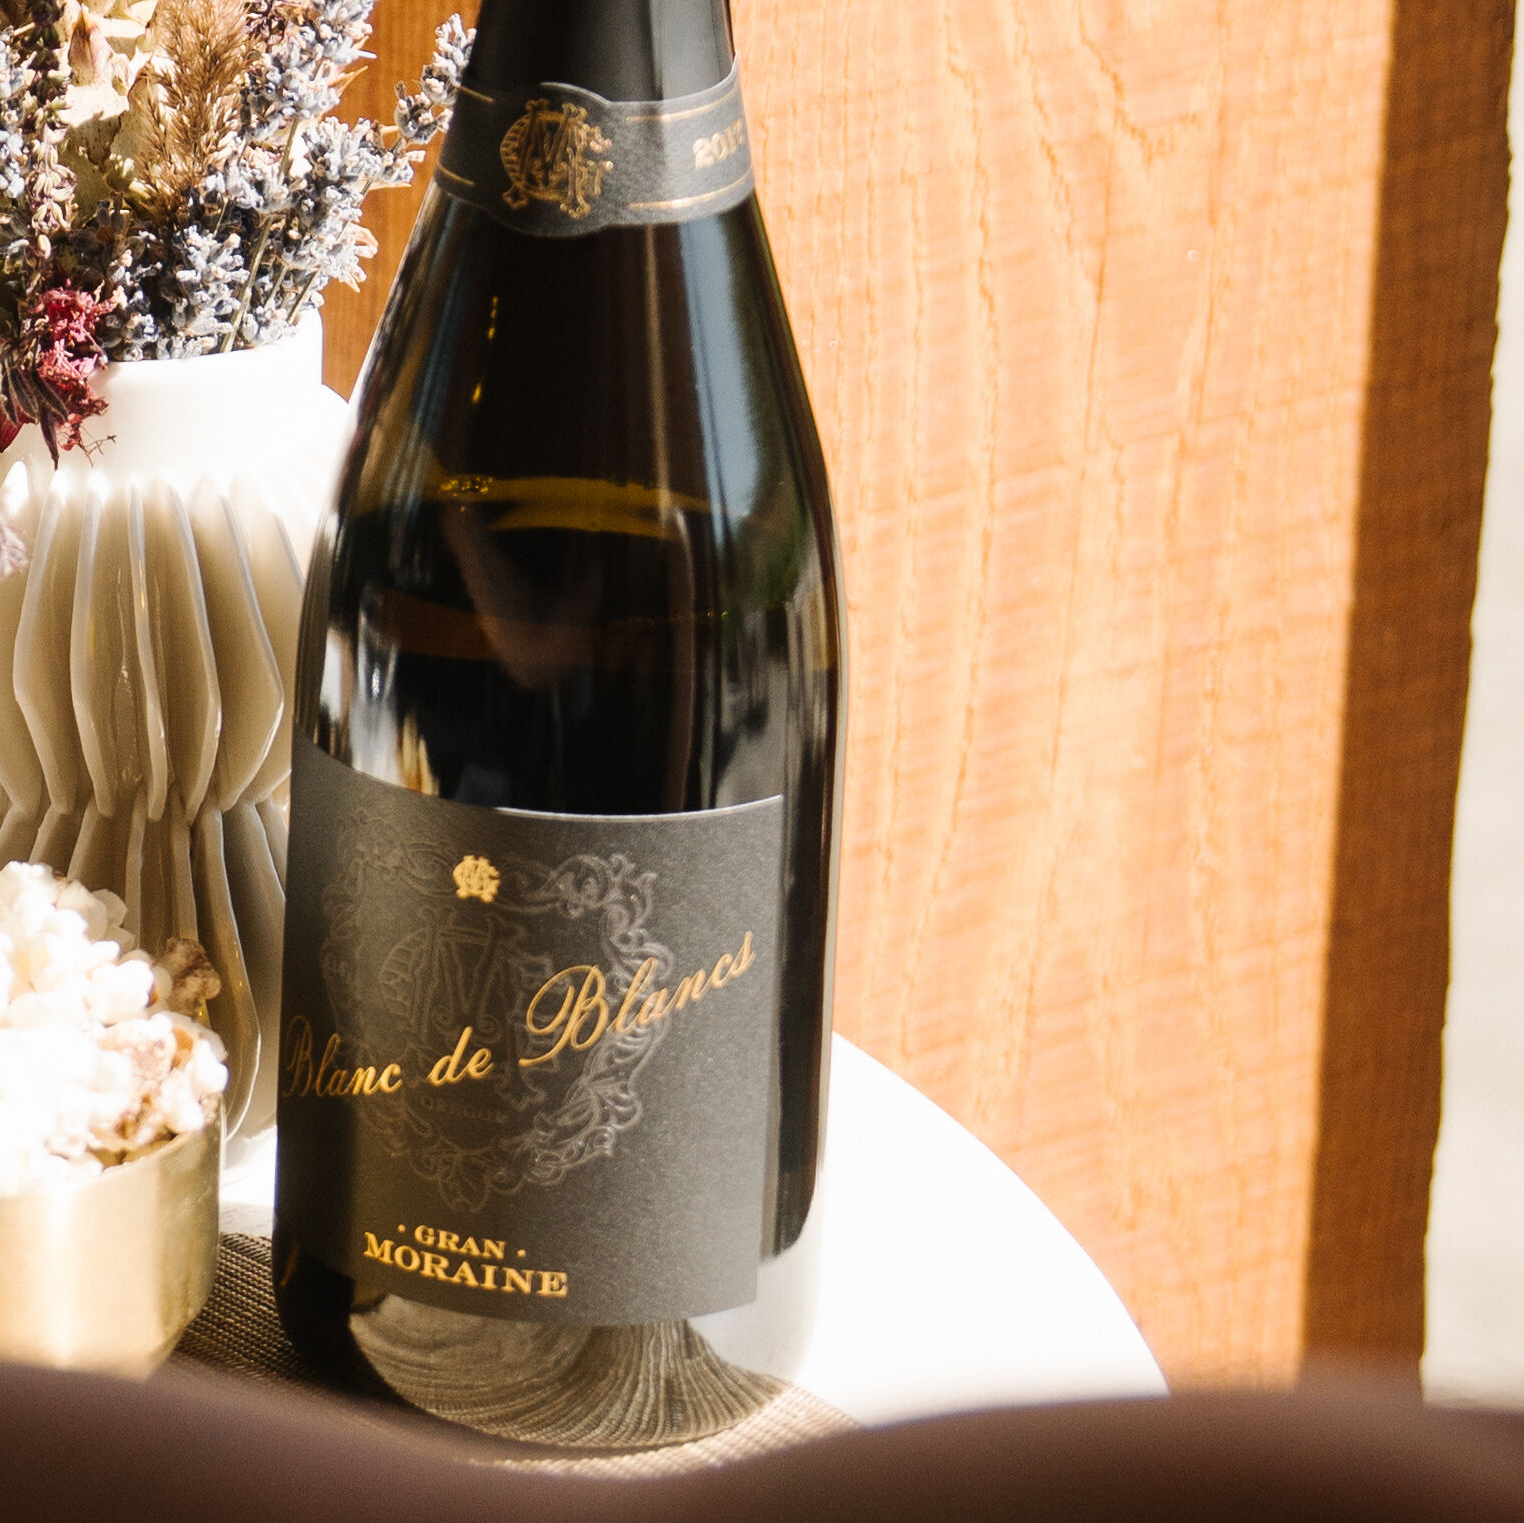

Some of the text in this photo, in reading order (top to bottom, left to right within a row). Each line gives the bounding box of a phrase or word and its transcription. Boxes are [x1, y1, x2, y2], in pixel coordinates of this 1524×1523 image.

[280, 929, 757, 1098] Blanc de Blancs
[362, 1231, 570, 1299] MORAINE
[413, 1223, 507, 1261] GRAN
